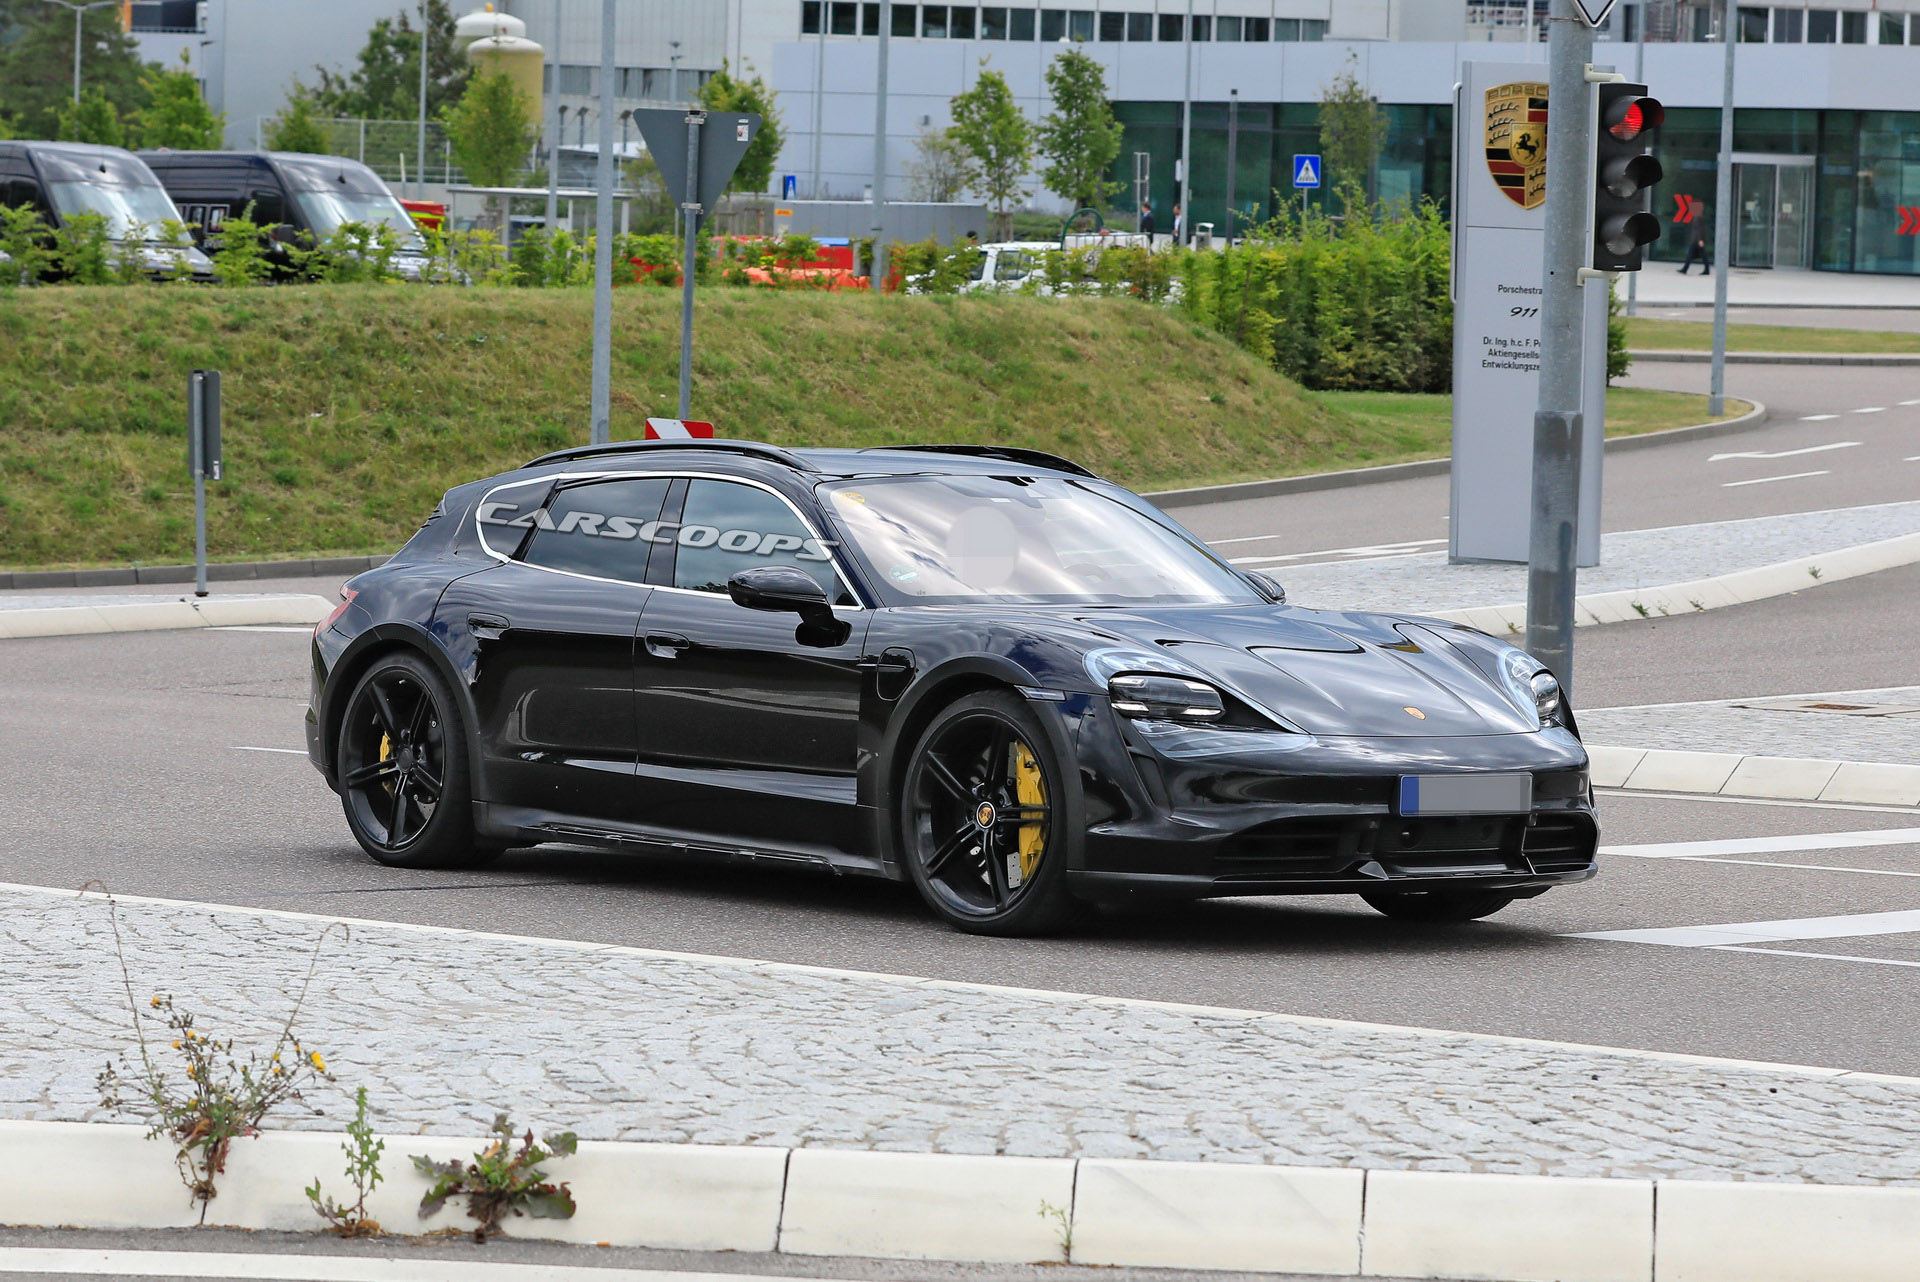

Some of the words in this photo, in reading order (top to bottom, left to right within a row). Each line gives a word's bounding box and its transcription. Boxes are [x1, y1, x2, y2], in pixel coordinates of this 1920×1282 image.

[1488, 85, 1549, 101] PORSC
[1510, 306, 1539, 318] 911
[1483, 336, 1494, 345] Dr.
[1495, 337, 1509, 348] Ing.
[1510, 338, 1524, 347] h.c.
[1525, 338, 1532, 347] F.
